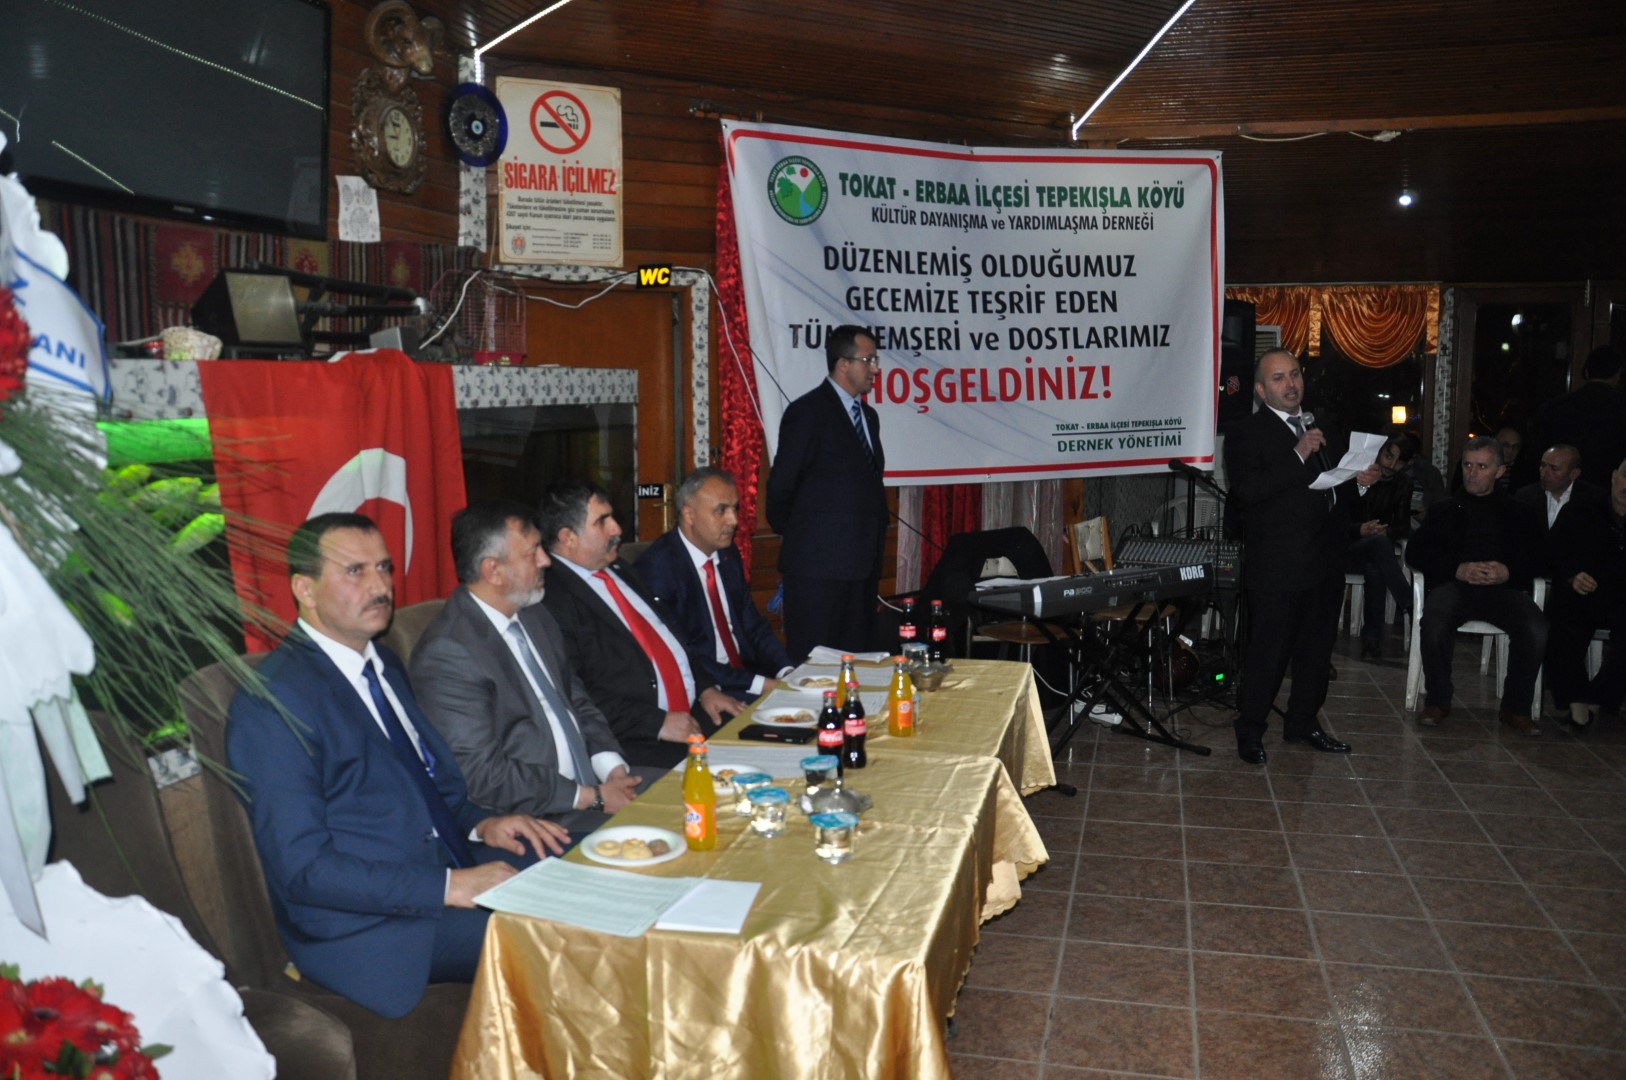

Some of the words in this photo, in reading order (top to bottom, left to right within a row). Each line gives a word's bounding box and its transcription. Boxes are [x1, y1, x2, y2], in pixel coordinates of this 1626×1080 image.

[504, 156, 558, 191] SİGARA
[562, 159, 617, 196] İÇİLMEZ
[839, 172, 897, 199] TOKAT
[902, 189, 910, 197] -
[915, 179, 970, 205] ERBAA
[975, 178, 1030, 213] İLÇESİ
[1035, 185, 1132, 213] TEPEKIŞLA
[1137, 180, 1185, 209] KÖYÜ
[872, 203, 916, 226] KÜLTÜR
[920, 210, 988, 232] DAYANIŞMA
[991, 219, 1006, 230] ve
[1007, 215, 1098, 235] YARDIMLAŞMA
[1102, 211, 1154, 231] DERNEĞİ
[640, 268, 670, 286] WC
[824, 243, 972, 284] DÜZENLEMİŞ
[981, 248, 1137, 278] OLDUĞUMUZ
[845, 281, 960, 314] GECEMİZE
[969, 285, 1045, 321] TEŞRİF
[1055, 290, 1118, 314] EDEN
[868, 321, 960, 357] EMŞERİ
[969, 332, 1000, 351] ve
[1008, 324, 1171, 351] DOSTLARIMIZ
[1056, 423, 1078, 431] TOKAT
[1086, 422, 1109, 430] ERBAA
[1110, 420, 1130, 431] İLÇESİ
[1131, 419, 1163, 430] TEPEKIŞLA
[1164, 416, 1182, 426] KÖYÜ
[1057, 437, 1113, 453] DERNEK
[1118, 431, 1182, 449] YÖNETİMİ
[1179, 564, 1205, 582] KORG
